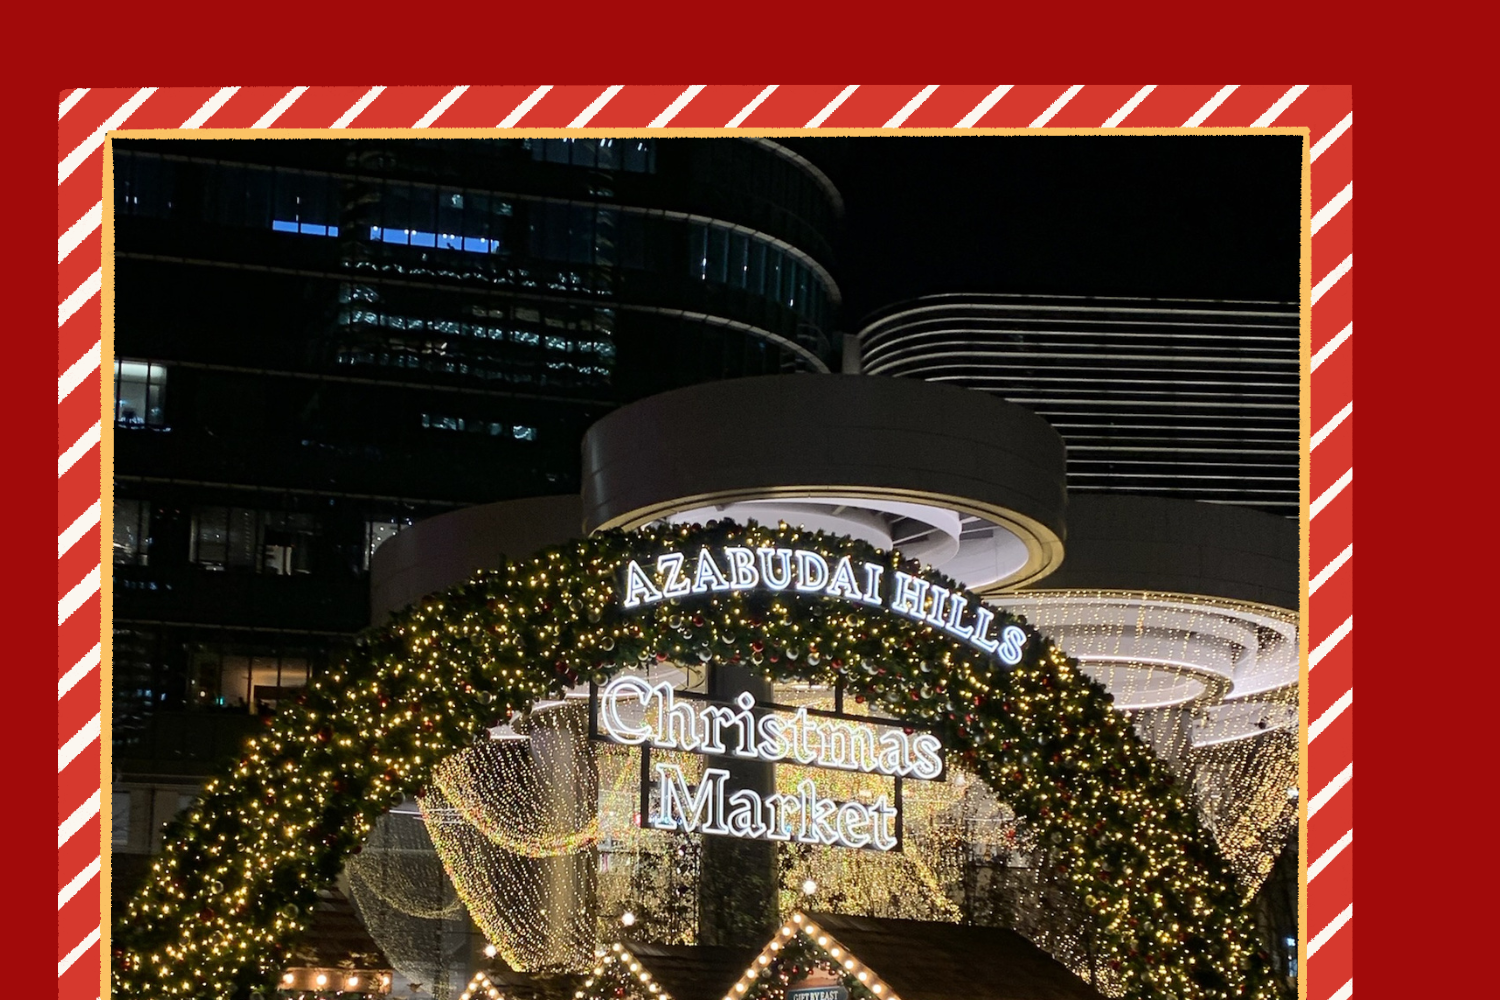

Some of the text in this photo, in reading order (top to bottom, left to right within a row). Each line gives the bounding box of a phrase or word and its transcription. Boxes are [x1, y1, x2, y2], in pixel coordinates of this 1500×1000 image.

[623, 546, 1028, 666] AZABUDAI HILLS
[600, 675, 943, 781] Christmas
[649, 761, 899, 852] Market
[820, 990, 839, 1000] EAST
